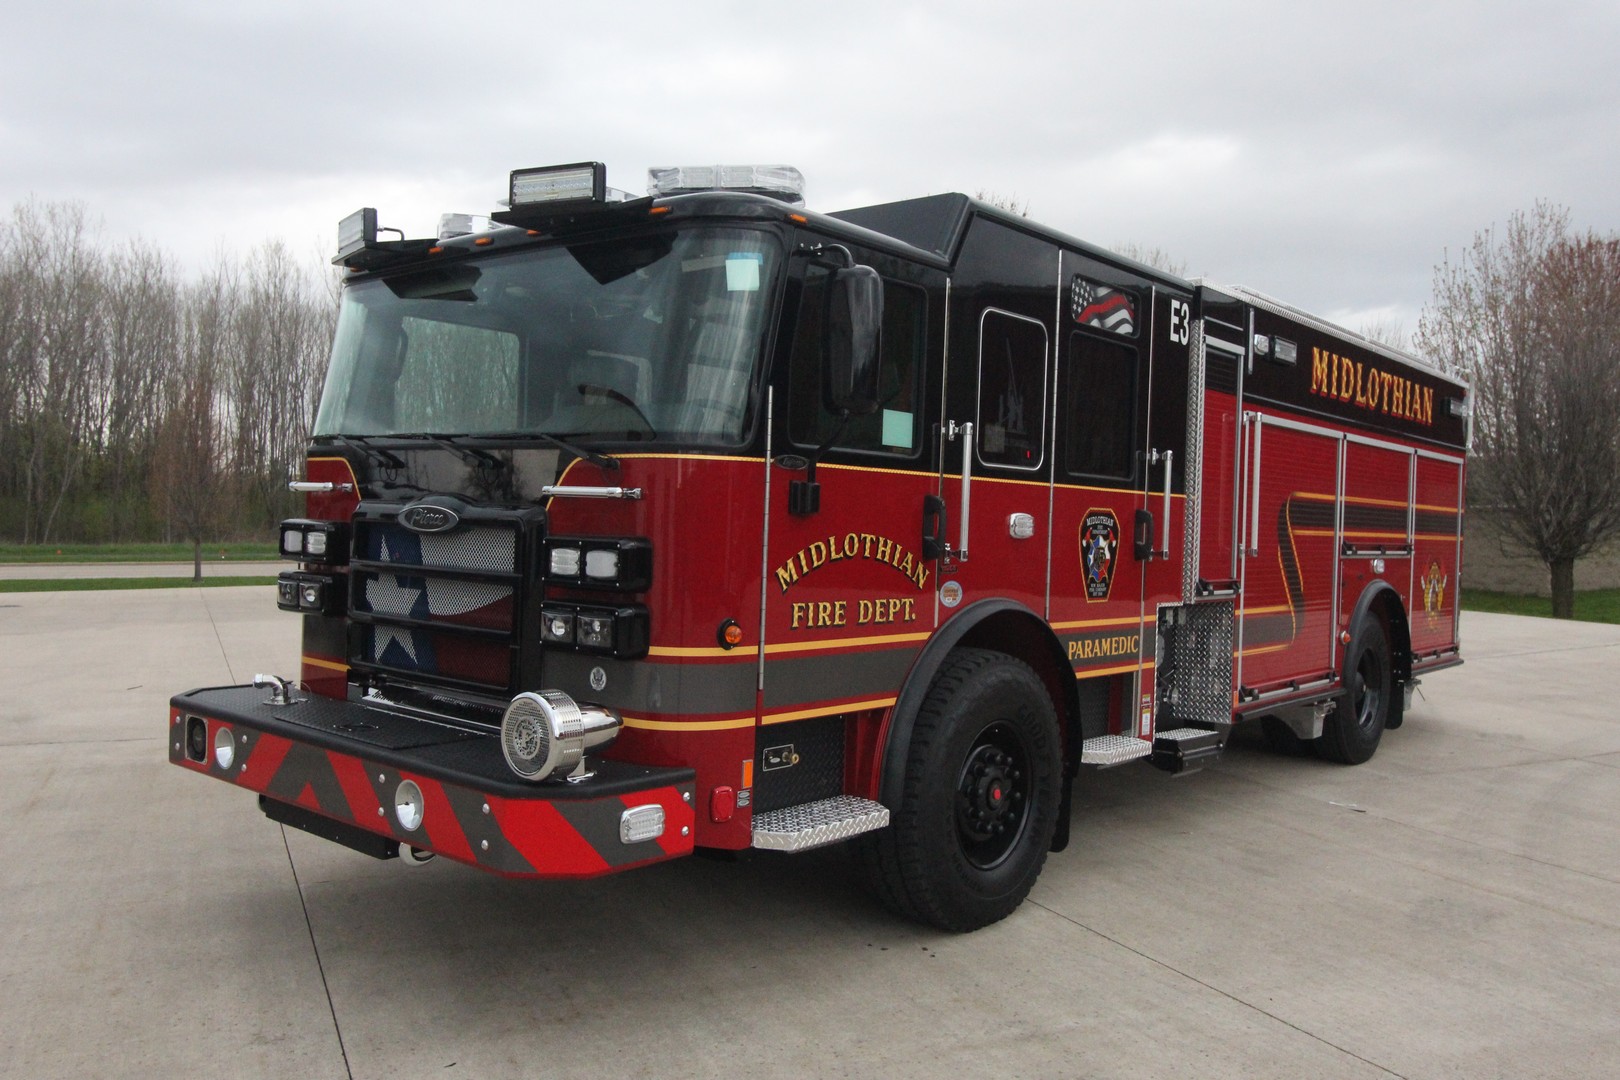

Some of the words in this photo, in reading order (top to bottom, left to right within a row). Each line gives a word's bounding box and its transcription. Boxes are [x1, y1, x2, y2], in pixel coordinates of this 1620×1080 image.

[1170, 299, 1190, 346] E3
[1310, 346, 1434, 426] MIDLOTHIAN
[775, 532, 930, 595] MIDLOTHIAN
[791, 600, 847, 629] FIRE
[858, 598, 916, 624] DEPT.
[1068, 635, 1139, 661] PARAMEDIC
